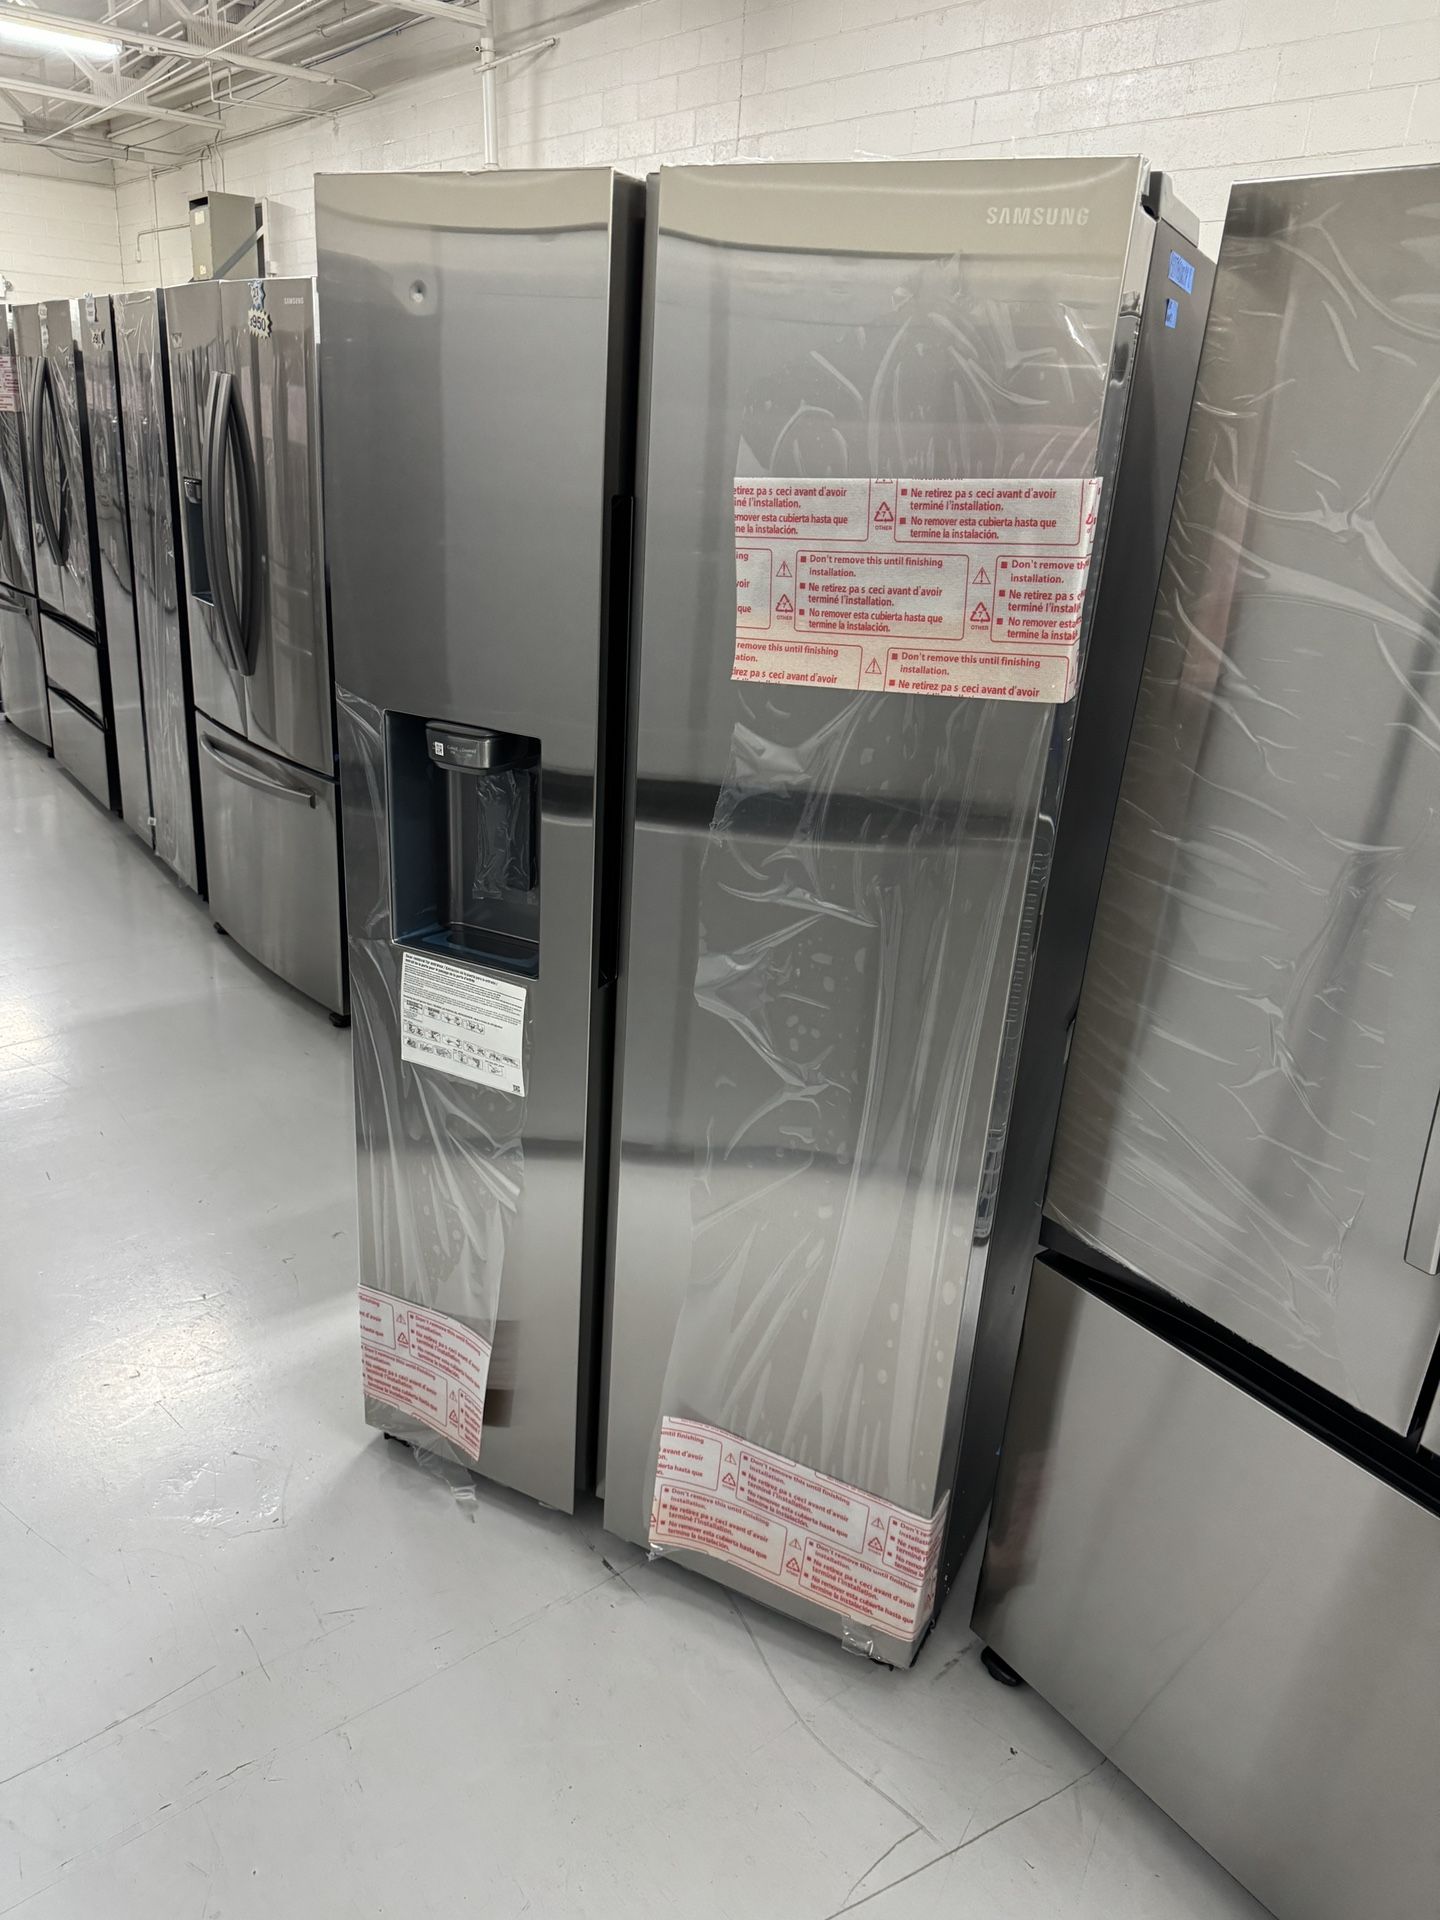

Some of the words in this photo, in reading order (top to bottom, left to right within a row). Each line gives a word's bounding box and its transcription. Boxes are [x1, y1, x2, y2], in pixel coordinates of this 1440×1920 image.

[986, 207, 1089, 226] SAMSUNG
[757, 488, 766, 497] pa
[776, 487, 792, 496] ceci
[794, 488, 817, 496] avant
[819, 487, 847, 497] d'avoir
[911, 488, 922, 498] Ne
[925, 489, 952, 498] retirez
[955, 490, 966, 501] pa
[976, 488, 994, 498] ceci
[997, 489, 1022, 499] avant
[1024, 488, 1056, 500] d'avoir
[910, 501, 944, 510] terminé
[947, 501, 1003, 512] l'installation.
[779, 514, 809, 523] cubierta
[811, 514, 831, 524] hasta
[833, 517, 848, 528] que
[911, 516, 922, 526] No
[924, 517, 957, 526] remover
[959, 519, 976, 527] esta
[978, 517, 1012, 527] cubierta
[1015, 517, 1037, 528] hasta
[1040, 520, 1056, 532] que
[748, 524, 753, 533] la
[756, 523, 798, 534] instalación.
[910, 529, 941, 538] termine
[943, 528, 950, 538] la
[952, 529, 999, 540] instalación.
[810, 555, 832, 563] Don't
[867, 556, 882, 565] this
[884, 556, 903, 565] until
[906, 557, 943, 568] finishing
[1011, 560, 1037, 569] Don't
[1040, 561, 1074, 570] remove
[809, 568, 856, 577] installation.
[1011, 573, 1064, 584] installation.
[809, 583, 819, 592] Ne
[821, 583, 846, 593] retirez
[849, 585, 860, 595] pa
[868, 585, 885, 594] ceci
[887, 587, 911, 595] avant
[913, 586, 943, 596] d'avoir
[808, 595, 839, 604] terminé
[841, 596, 894, 606] l'installation.
[1009, 589, 1021, 599] Ne
[1024, 590, 1052, 600] retirez
[1055, 592, 1068, 603] pa
[738, 605, 751, 614] que
[1008, 603, 1043, 612] terminé
[809, 608, 820, 617] No
[821, 610, 851, 619] remover
[854, 612, 868, 620] esta
[871, 611, 902, 622] cubierta
[904, 612, 926, 623] hasta
[927, 615, 943, 625] que
[1008, 617, 1020, 626] No
[1022, 618, 1057, 628] remover
[809, 620, 836, 629] termine
[839, 621, 845, 630] la
[847, 622, 891, 632] instalación.
[1008, 629, 1040, 639] termine
[1042, 630, 1048, 639] la
[737, 642, 766, 651] remove
[768, 642, 782, 652] this
[784, 643, 802, 652] until
[804, 645, 839, 657] finishing
[902, 652, 925, 661] Don't
[927, 654, 959, 663] remove
[961, 654, 977, 664] this
[979, 655, 1000, 665] until
[1001, 656, 1040, 669] finishing
[750, 669, 760, 678] pa
[769, 671, 784, 679] ceci
[787, 672, 808, 682] avant
[810, 672, 837, 684] d'avoir
[900, 665, 949, 676] installation.
[899, 679, 910, 689] Ne
[912, 680, 938, 690] retirez
[941, 683, 952, 693] pa
[962, 684, 979, 693] ceci
[982, 685, 1007, 695] avant
[1008, 686, 1040, 697] d'avoir
